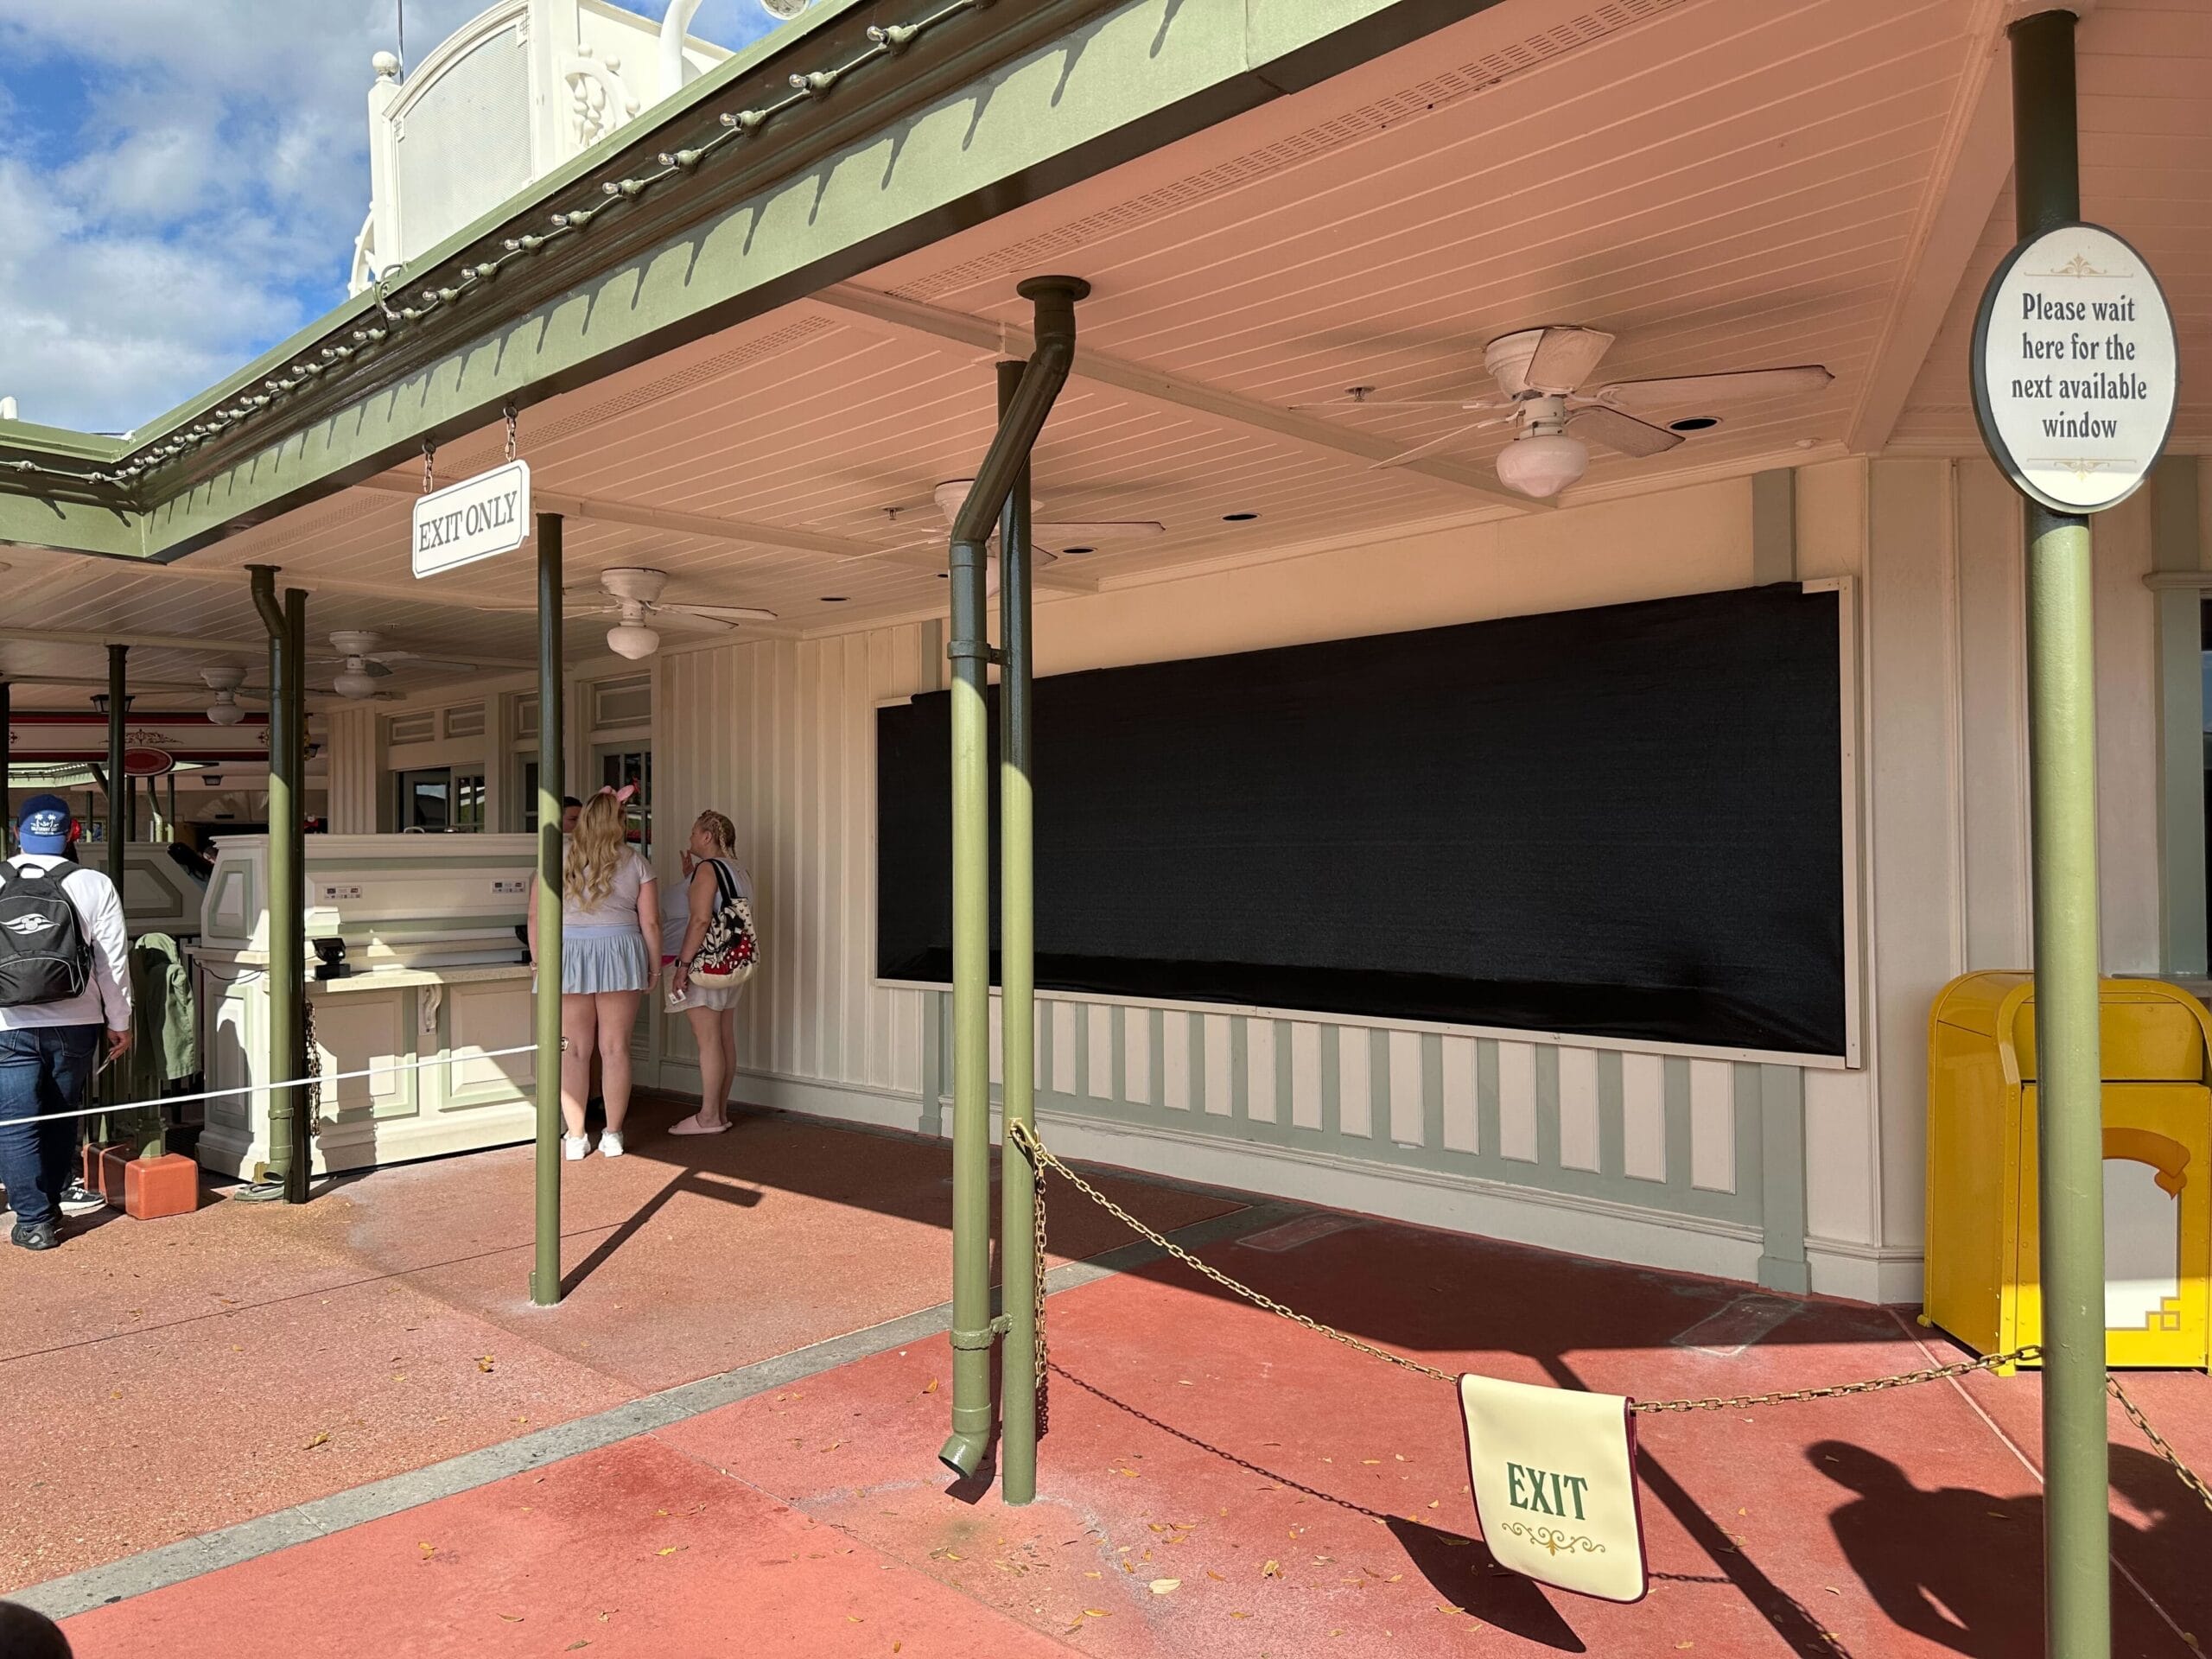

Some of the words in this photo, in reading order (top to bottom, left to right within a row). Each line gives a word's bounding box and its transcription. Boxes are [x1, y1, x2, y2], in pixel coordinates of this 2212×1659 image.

[2022, 292, 2086, 321] Please
[2092, 295, 2136, 321] wait
[2022, 332, 2064, 359] here
[2070, 333, 2100, 360] for
[2106, 334, 2135, 360] the
[2012, 374, 2053, 398] next
[2059, 372, 2147, 400] available
[2042, 411, 2118, 438] window
[419, 510, 463, 553] EXIT
[466, 490, 518, 536] ONLY
[1507, 1462, 1588, 1521] EXIT
